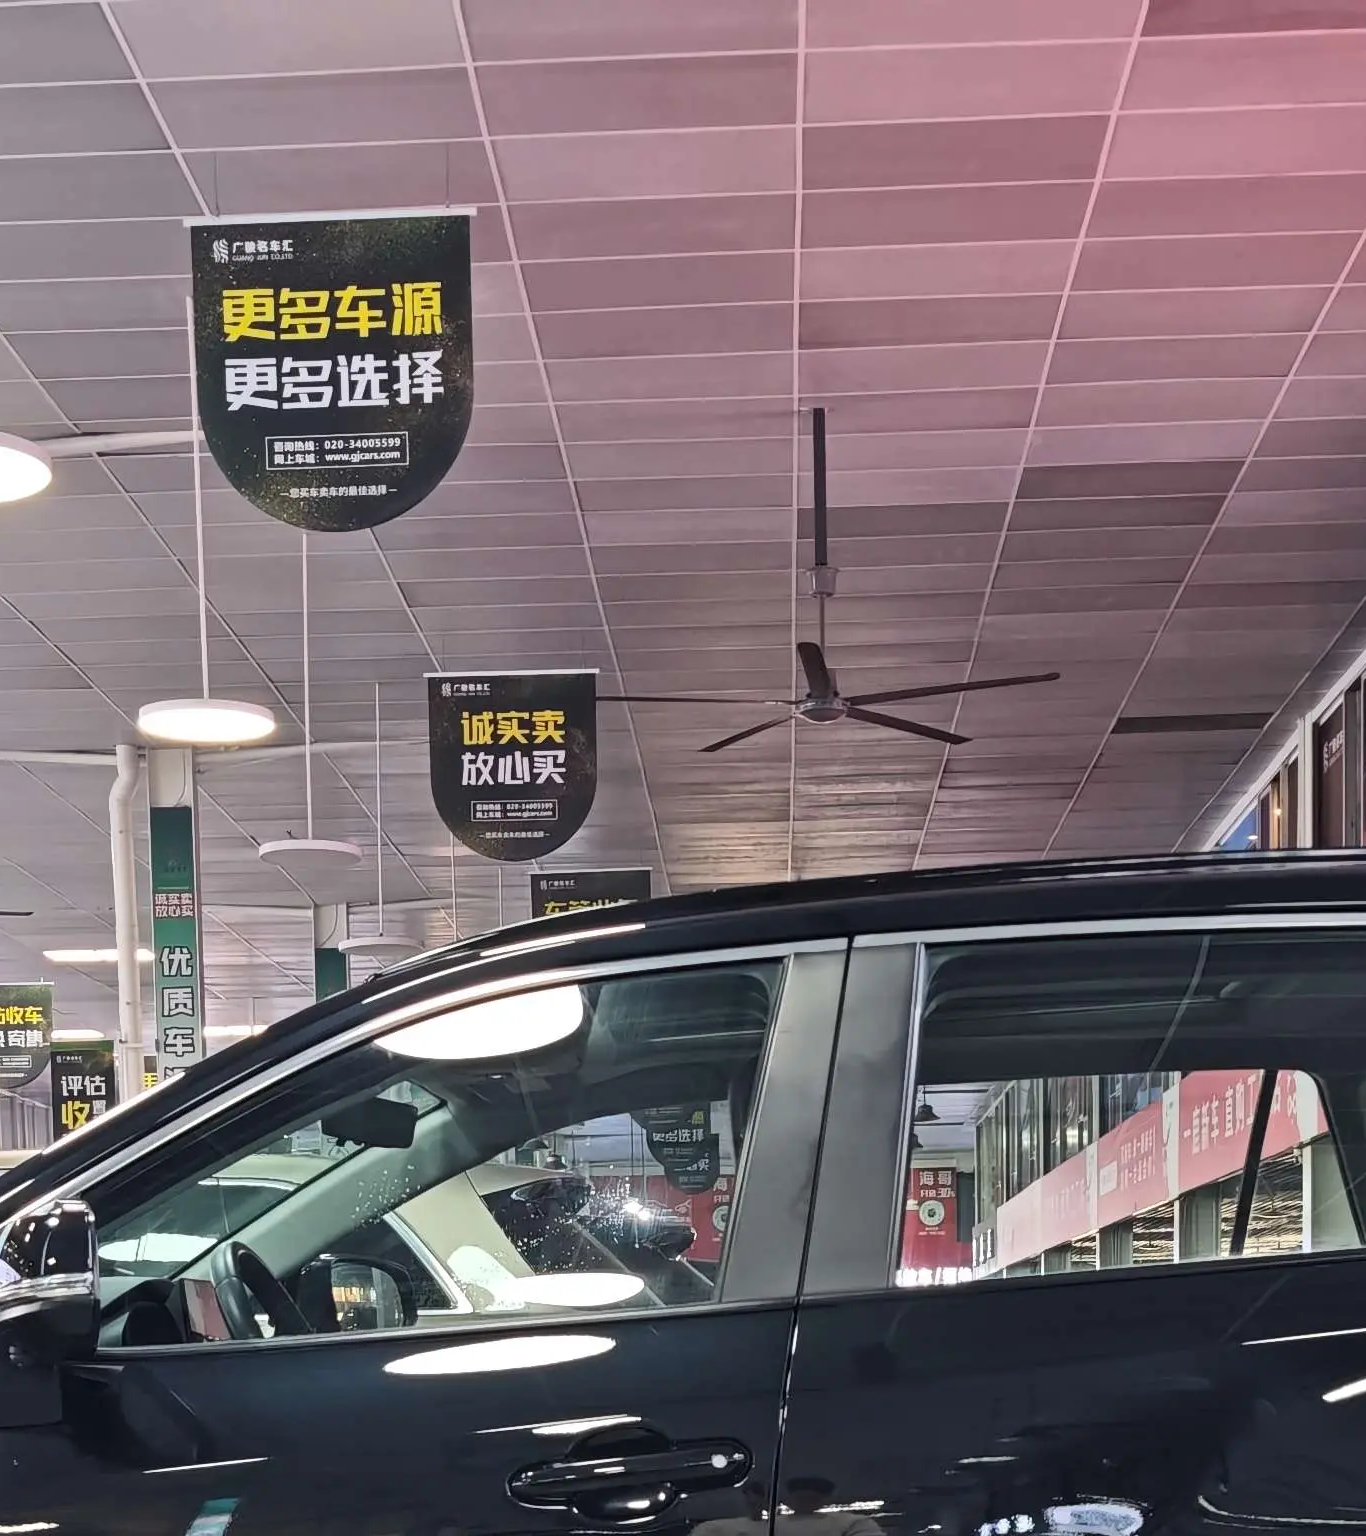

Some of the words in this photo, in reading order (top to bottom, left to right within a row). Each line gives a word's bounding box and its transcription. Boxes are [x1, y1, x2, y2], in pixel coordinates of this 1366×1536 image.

[222, 281, 443, 342] 更多车源
[224, 349, 445, 412] 更多选择
[324, 437, 402, 450] 020-34005599
[461, 709, 566, 745] 诚实卖
[461, 750, 567, 786] 放心买
[60, 1075, 106, 1097] 评估
